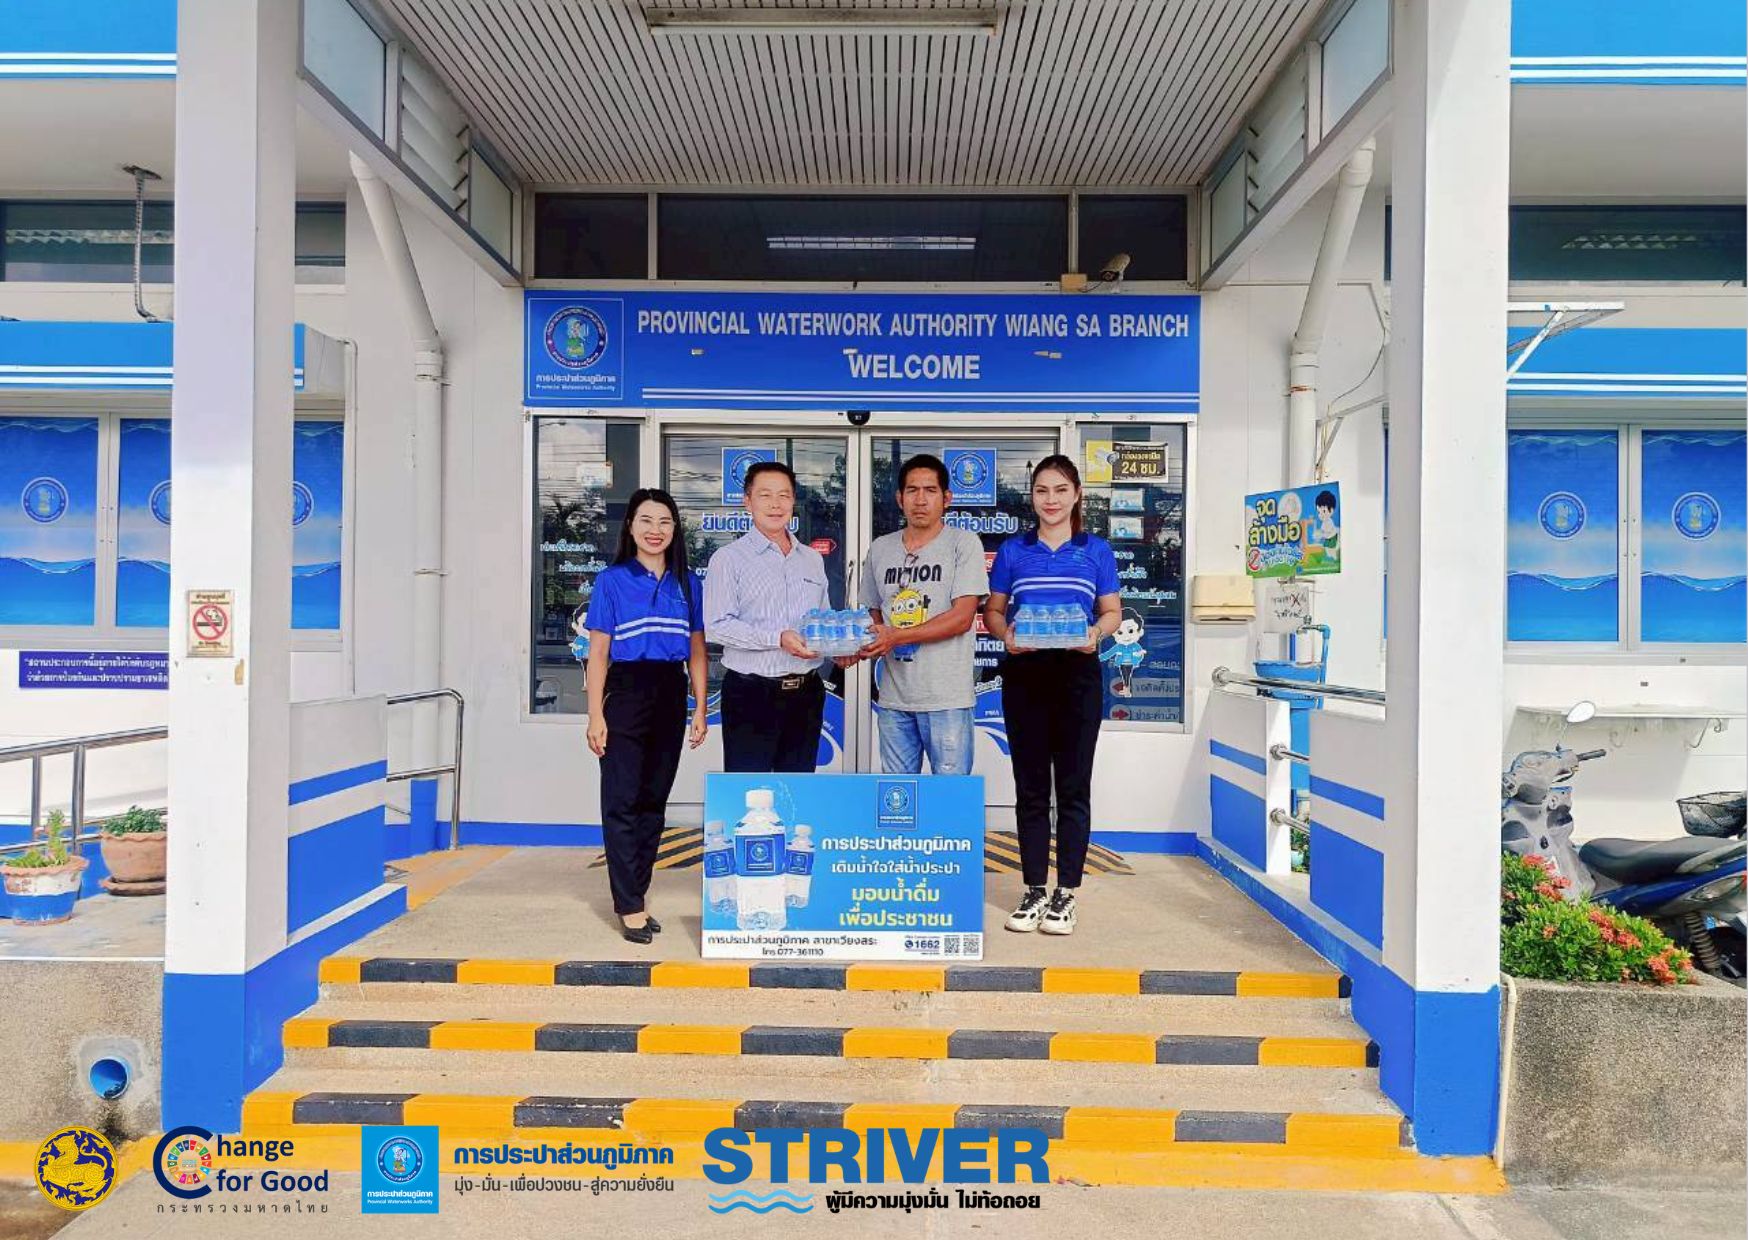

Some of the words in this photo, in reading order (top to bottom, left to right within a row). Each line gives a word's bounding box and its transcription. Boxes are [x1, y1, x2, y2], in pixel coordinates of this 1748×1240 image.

[637, 310, 750, 335] PROVINCIAL
[758, 311, 881, 337] WATERWORK
[890, 313, 998, 338] AUTHORITY
[1005, 313, 1068, 338] WIANG
[1076, 314, 1101, 338] SA
[1109, 314, 1190, 338] BRANCH
[849, 353, 981, 380] WELCOME
[1121, 461, 1137, 475] 24
[1248, 515, 1303, 547] ล้างมือ
[822, 835, 971, 856] การประปาส่วนภูมิภาค
[852, 878, 940, 903] มอบน้ำดื่ม
[839, 903, 953, 927] เพื่อประชาชน
[708, 935, 809, 947] การประปาส่วนภูมิภาค
[813, 935, 878, 946] สาขาเวียงสระ
[915, 940, 940, 949] 1662
